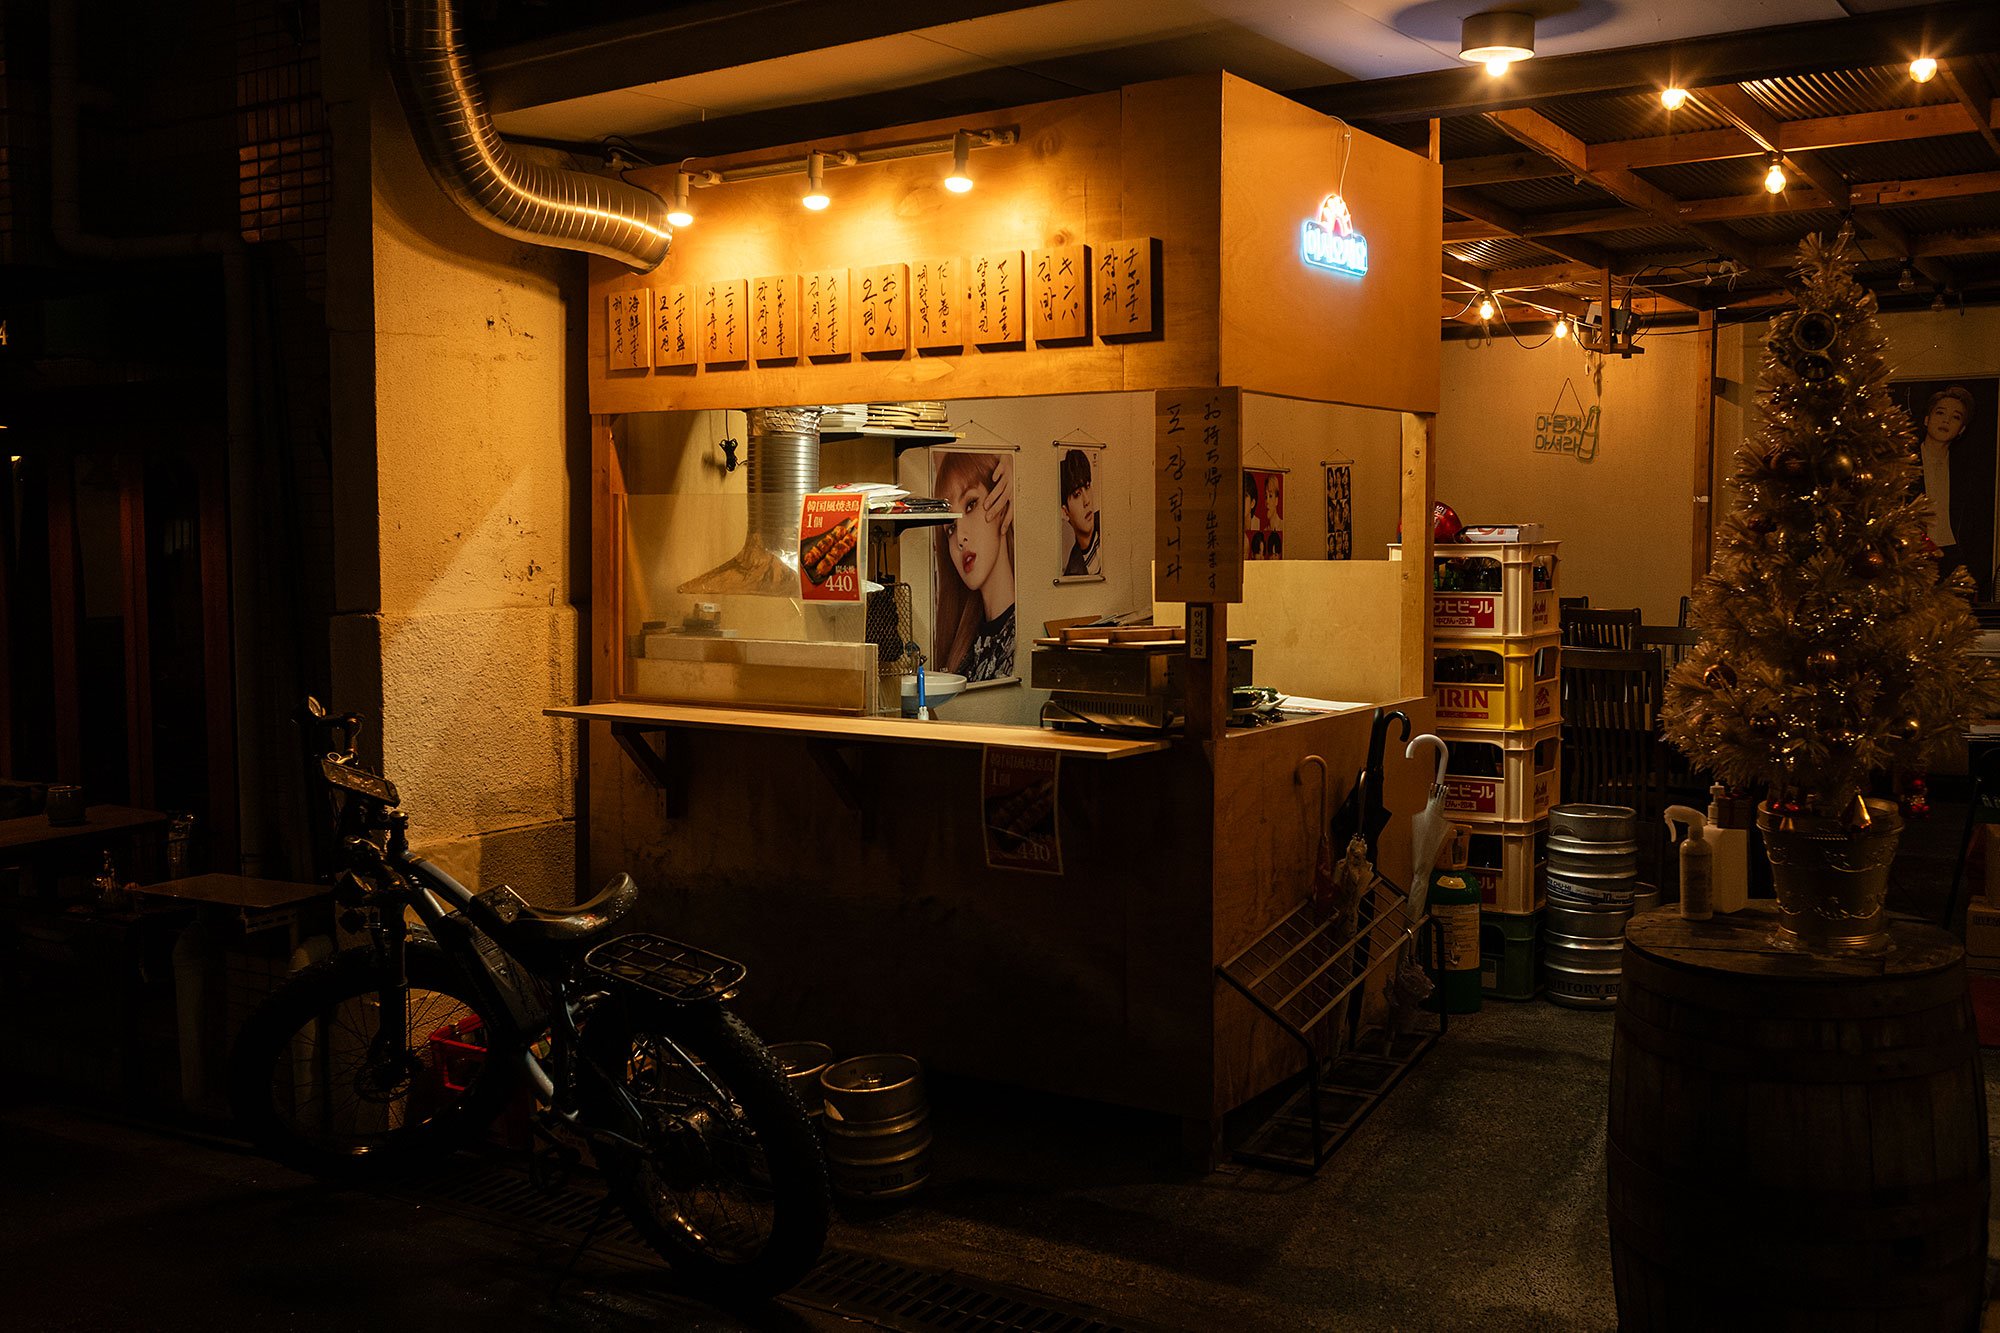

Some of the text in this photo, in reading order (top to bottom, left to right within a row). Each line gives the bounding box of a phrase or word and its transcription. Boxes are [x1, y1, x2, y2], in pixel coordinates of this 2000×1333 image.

[808, 275, 820, 342] 김치전
[862, 278, 878, 336] 오뎅
[882, 273, 898, 337] おでん
[937, 260, 950, 334] だし巻き
[1038, 255, 1057, 322] 김밥
[1059, 256, 1078, 321] キンパ
[1100, 247, 1118, 313] 잡채
[612, 295, 624, 354] 해물전
[706, 286, 717, 350] 부추전
[756, 281, 769, 345] 감자전
[806, 500, 860, 513] 韓国風焼き鳥
[1164, 403, 1186, 585] 포장됩니다
[825, 575, 853, 592] 440
[1434, 688, 1489, 709] IRIN
